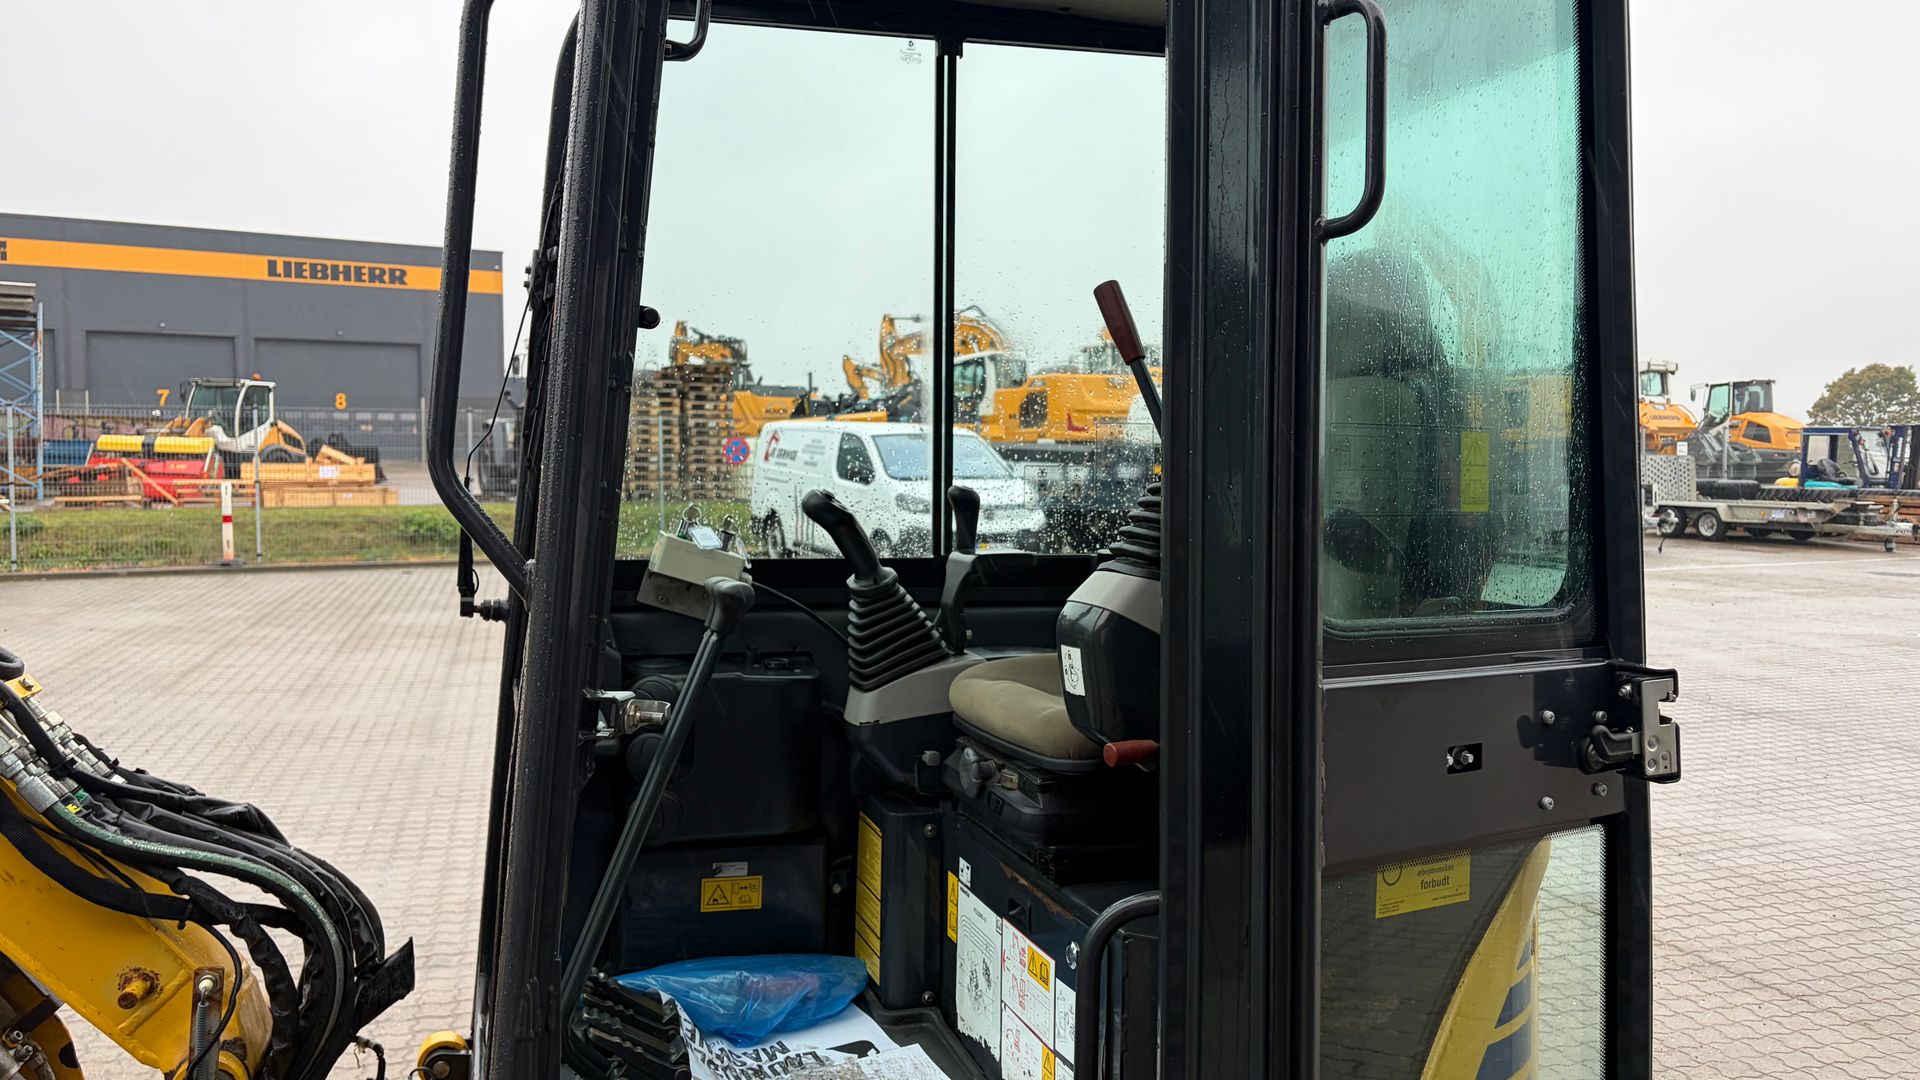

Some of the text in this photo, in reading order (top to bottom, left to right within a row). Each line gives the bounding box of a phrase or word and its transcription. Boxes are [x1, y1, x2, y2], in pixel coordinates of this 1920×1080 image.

[267, 259, 408, 285] LIEBHERR
[156, 388, 170, 407] 7
[335, 392, 347, 410] 8
[1420, 876, 1450, 891] forbudt
